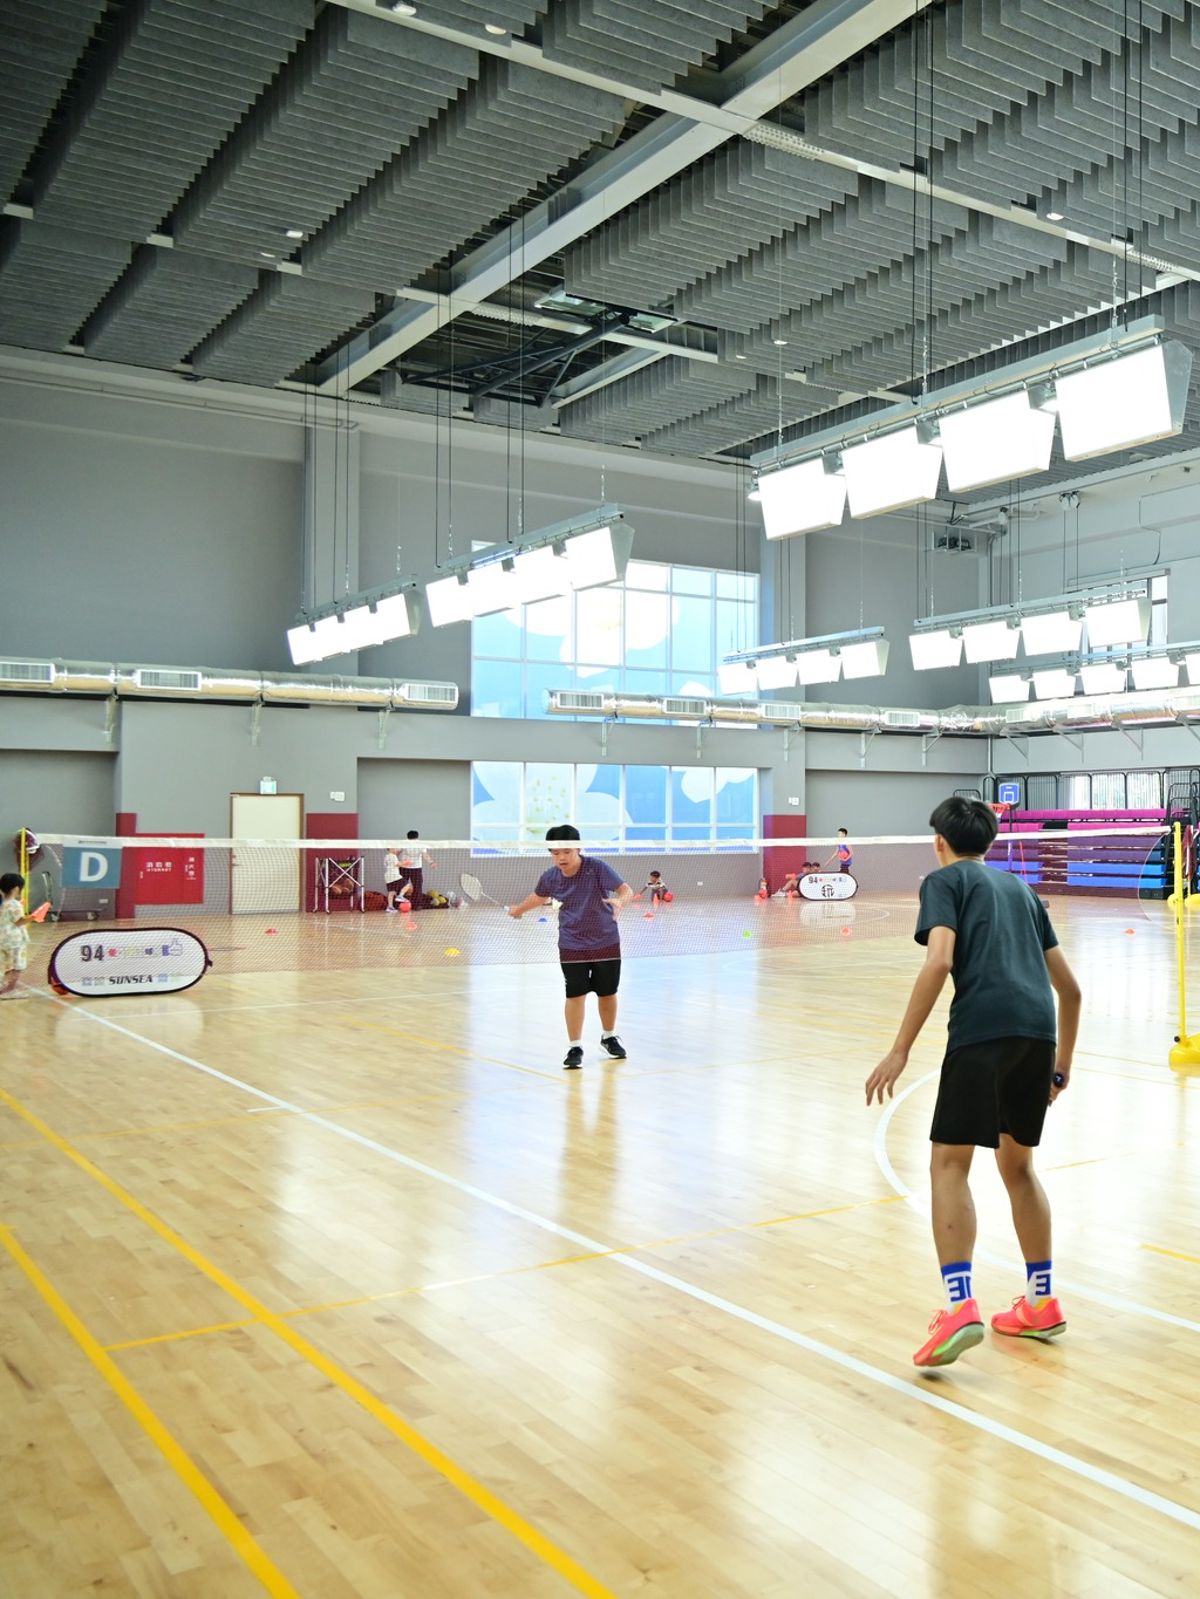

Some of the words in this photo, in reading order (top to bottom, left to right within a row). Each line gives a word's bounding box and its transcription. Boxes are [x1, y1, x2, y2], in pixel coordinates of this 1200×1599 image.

[79, 852, 109, 882] D
[80, 944, 105, 962] 94
[108, 974, 153, 986] SUNSEA
